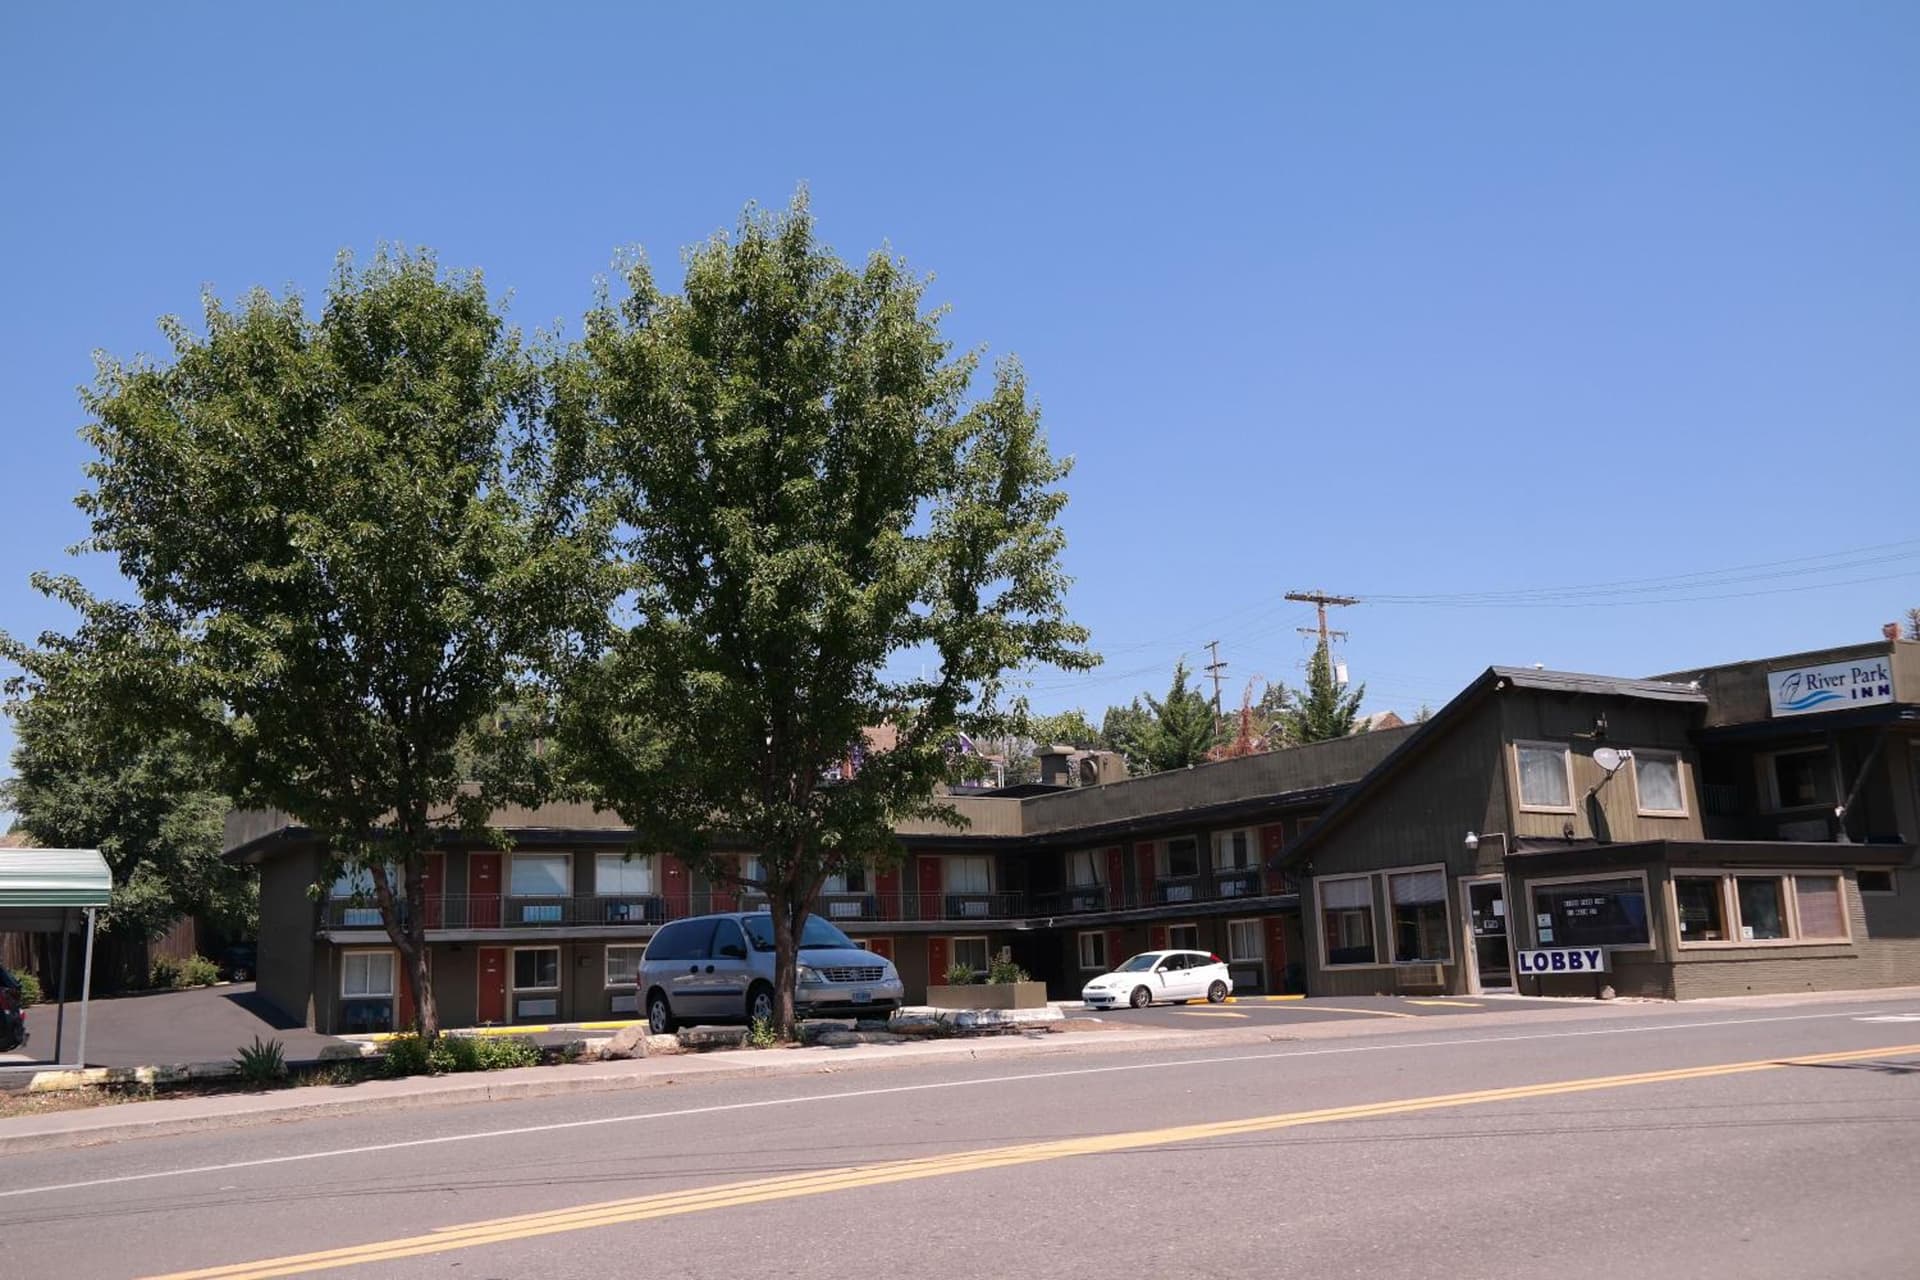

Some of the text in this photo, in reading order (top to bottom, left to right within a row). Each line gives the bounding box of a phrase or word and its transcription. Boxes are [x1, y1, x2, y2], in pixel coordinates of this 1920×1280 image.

[1806, 663, 1889, 690] River Park
[1852, 684, 1890, 699] INN
[1520, 950, 1600, 972] LOBBY
